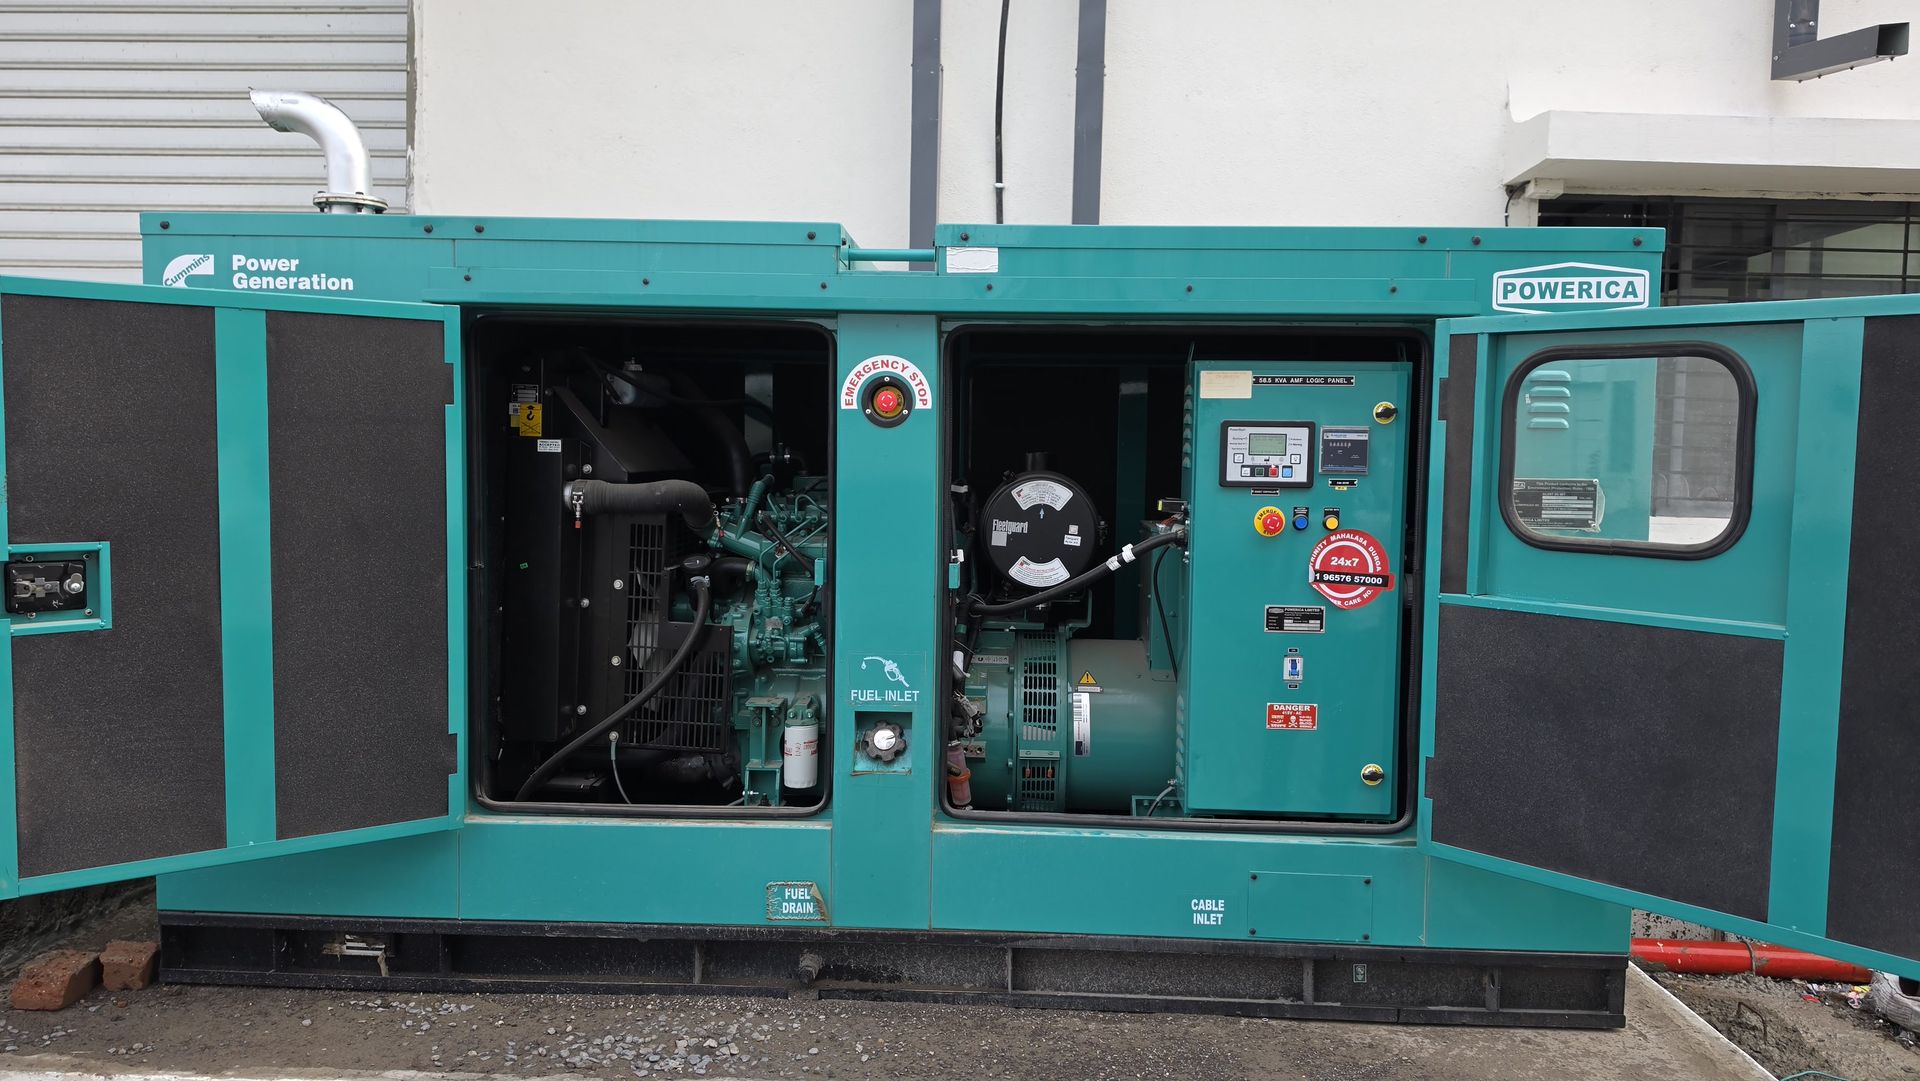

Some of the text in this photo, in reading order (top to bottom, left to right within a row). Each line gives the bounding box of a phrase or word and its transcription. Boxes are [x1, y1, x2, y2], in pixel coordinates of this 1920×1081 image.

[232, 254, 299, 272] Power
[164, 254, 210, 287] Cummins
[232, 272, 354, 291] Generation
[1502, 280, 1639, 300] POWERICA
[844, 359, 928, 406] EMERGENCY STOP
[992, 518, 1028, 535] Fleetguard
[1330, 533, 1367, 546] MAHALASA
[1330, 556, 1360, 567] 24x7
[1323, 574, 1352, 582] 96576
[1353, 576, 1383, 584] 57000
[1344, 598, 1362, 606] CARE
[1273, 704, 1310, 712] DANGER
[784, 888, 811, 900] FUEL
[782, 901, 814, 914] DRAIN
[1191, 899, 1225, 911] CABLE
[1193, 912, 1223, 925] INLET
